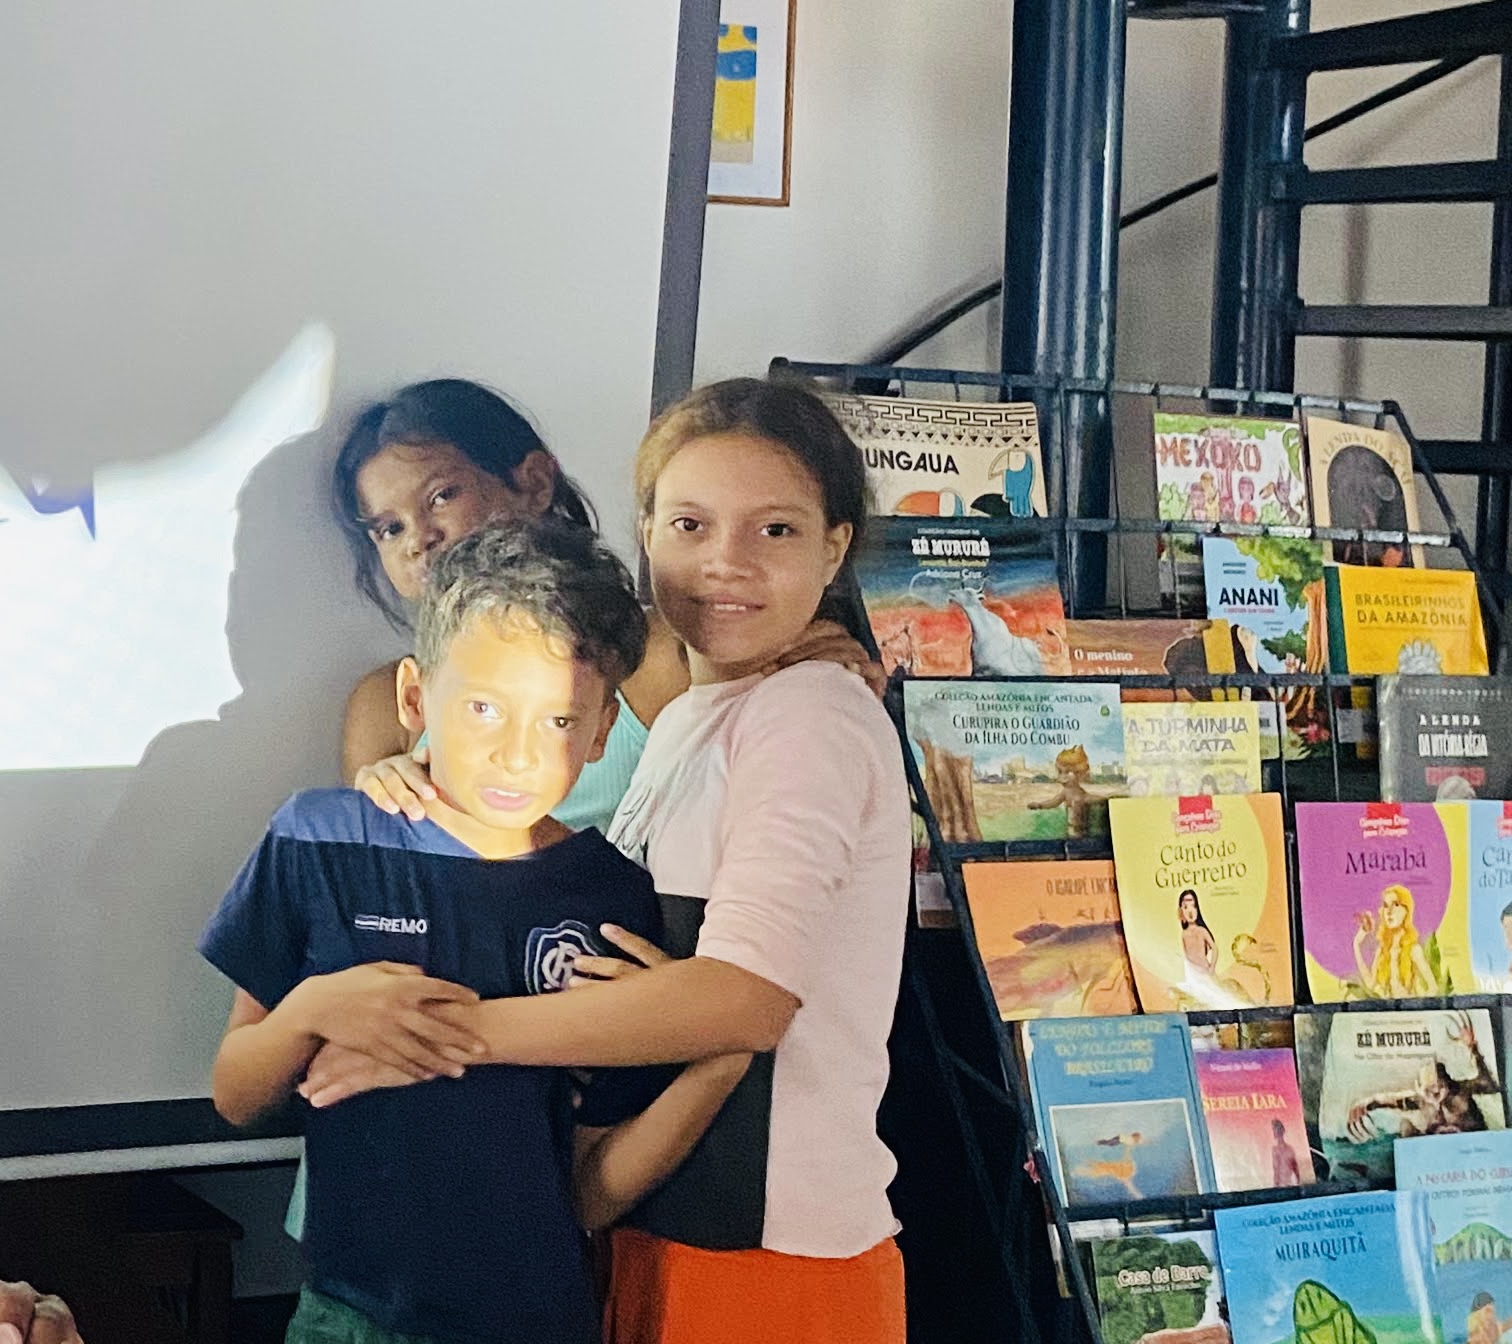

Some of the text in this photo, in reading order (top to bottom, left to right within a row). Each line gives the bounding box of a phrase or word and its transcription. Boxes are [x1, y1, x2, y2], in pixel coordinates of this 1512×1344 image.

[1218, 587, 1279, 607] ANANI
[1357, 609, 1468, 626] DA AMAZÔNIA
[1073, 648, 1134, 662] O menino
[952, 714, 1080, 732] CURUPIRA O GUARDIÃO
[1149, 717, 1250, 735] TURMINHA
[964, 732, 980, 745] DA
[1010, 732, 1028, 746] DO
[1029, 732, 1071, 747] COMBU
[1142, 737, 1236, 754] DA MATA
[1159, 839, 1238, 867] Canto do
[1344, 844, 1428, 875] Marabá
[1154, 862, 1248, 889] Guerreiro
[378, 916, 429, 935] REMO
[1275, 1231, 1368, 1263] MUIRAQUITÃ
